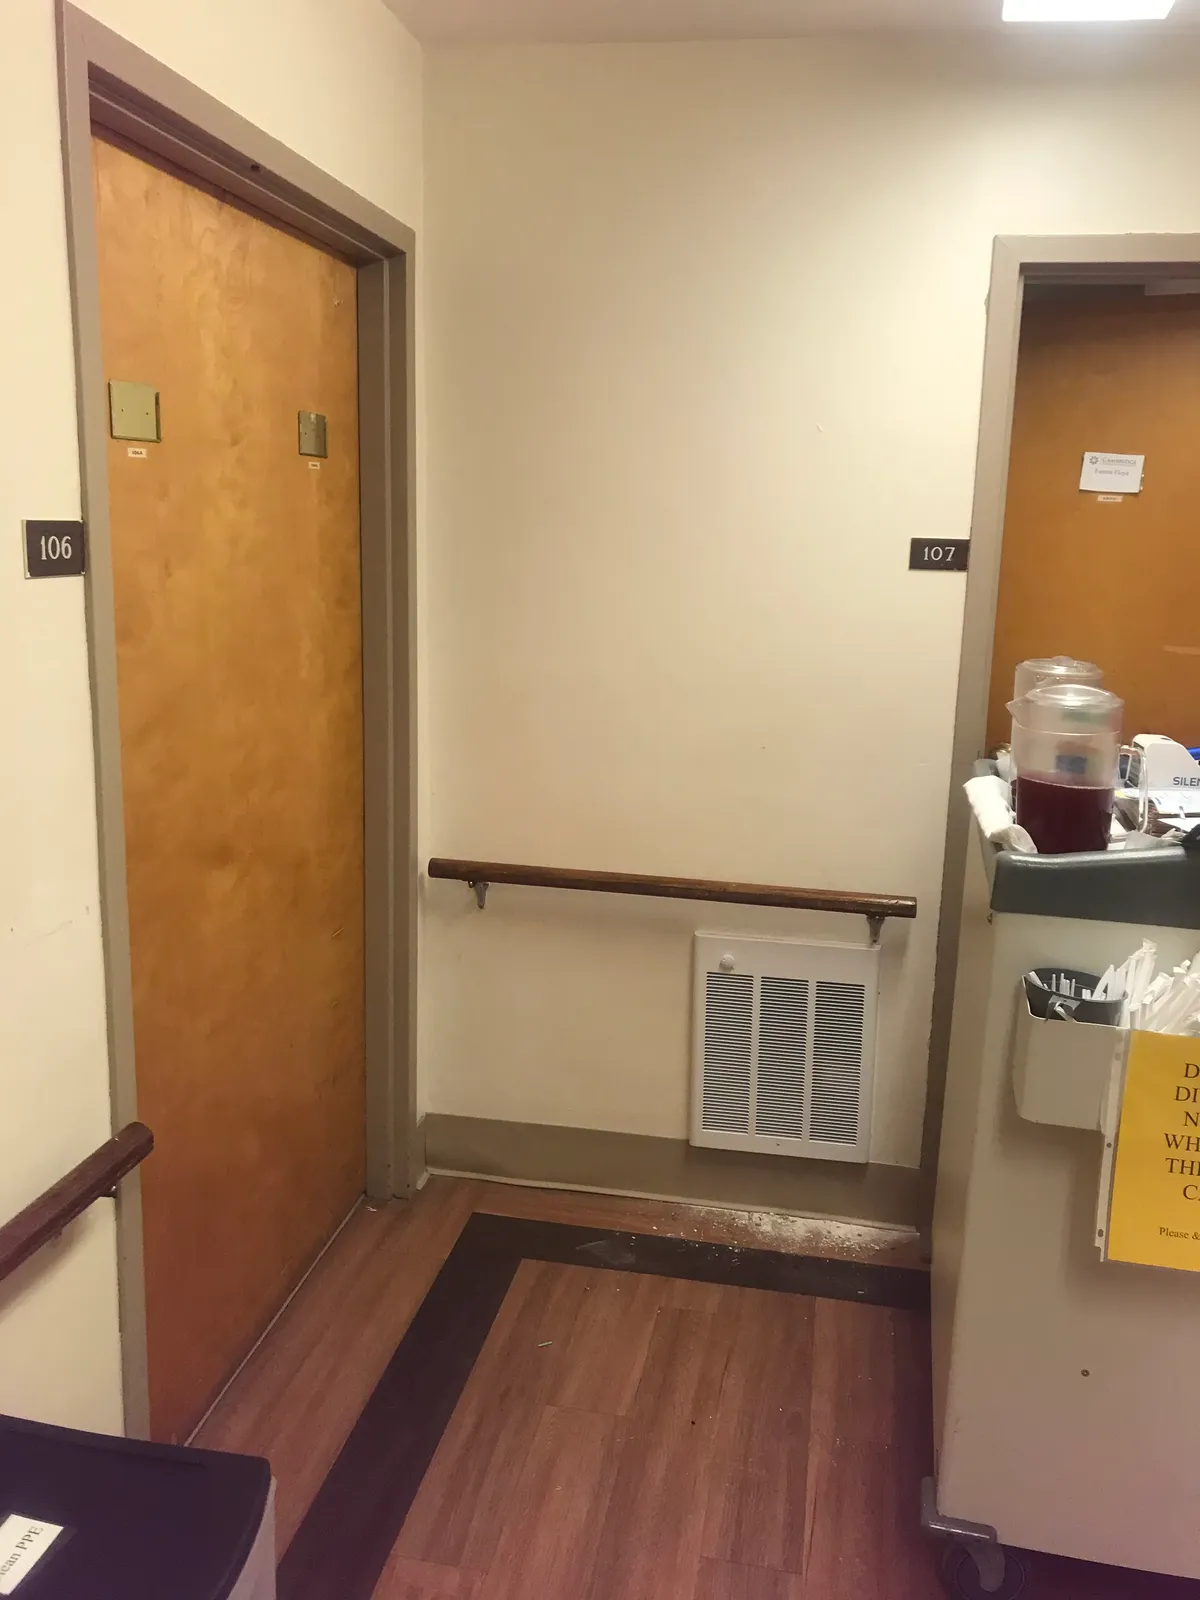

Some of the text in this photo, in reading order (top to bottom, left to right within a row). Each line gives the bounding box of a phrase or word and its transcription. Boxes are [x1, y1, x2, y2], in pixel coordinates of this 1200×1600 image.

[40, 535, 73, 560] 106
[923, 546, 956, 562] 107
[1182, 1184, 1200, 1202] C
[1158, 1226, 1190, 1240] Please
[15, 1526, 44, 1550] PPE
